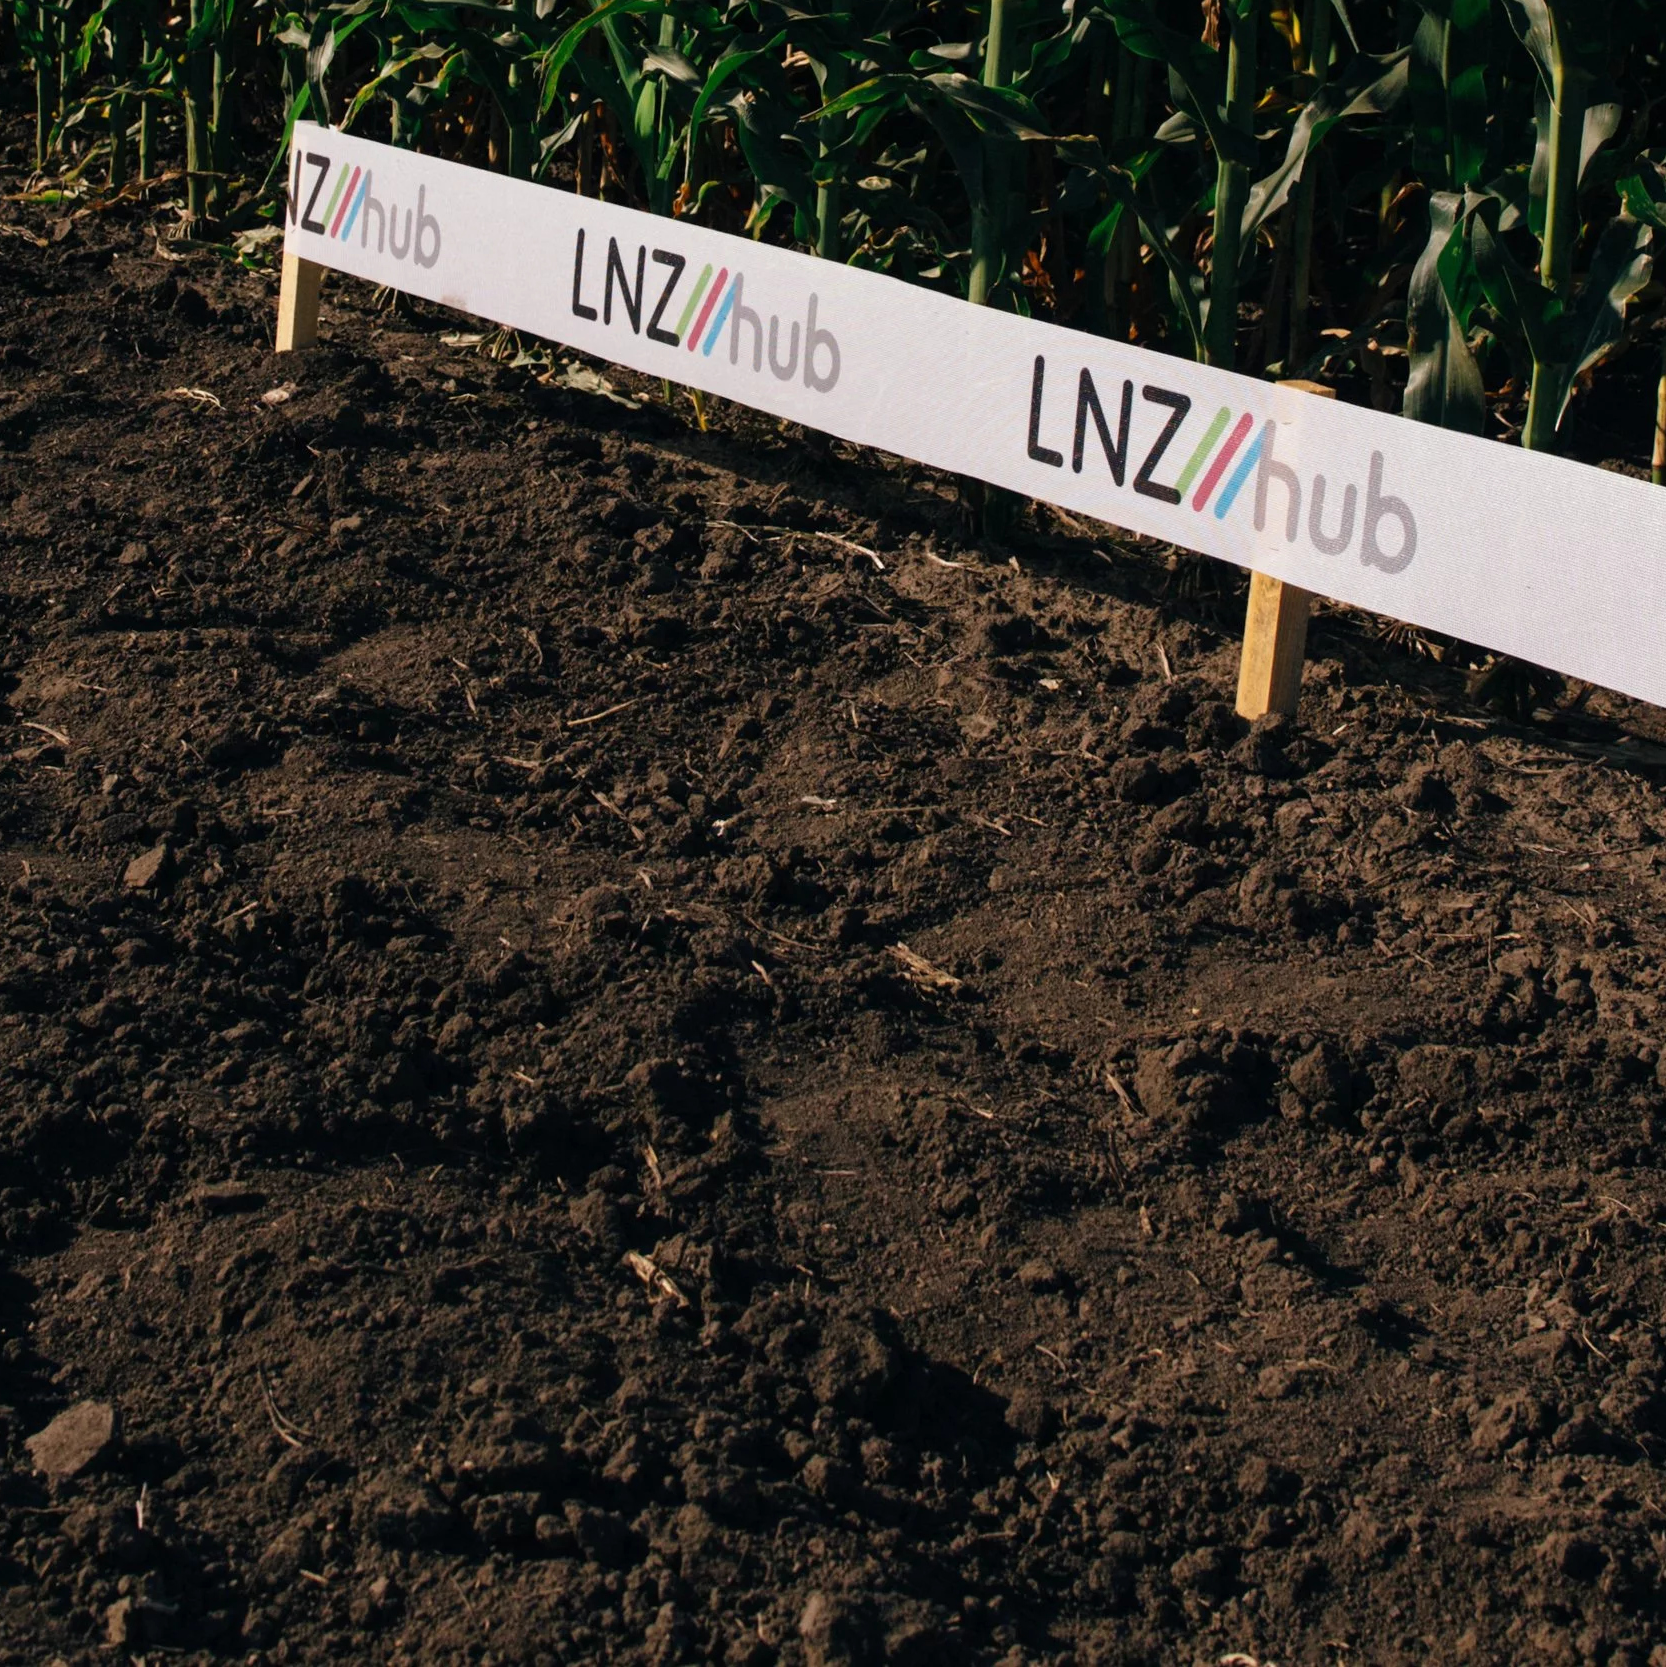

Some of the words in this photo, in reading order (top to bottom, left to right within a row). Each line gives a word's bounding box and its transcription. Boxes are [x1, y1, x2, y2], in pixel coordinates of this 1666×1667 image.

[361, 169, 441, 269] hub
[572, 228, 687, 347] LNZ
[729, 272, 841, 394] hub
[1027, 354, 1192, 505] LNZ
[1253, 419, 1417, 575] hub
